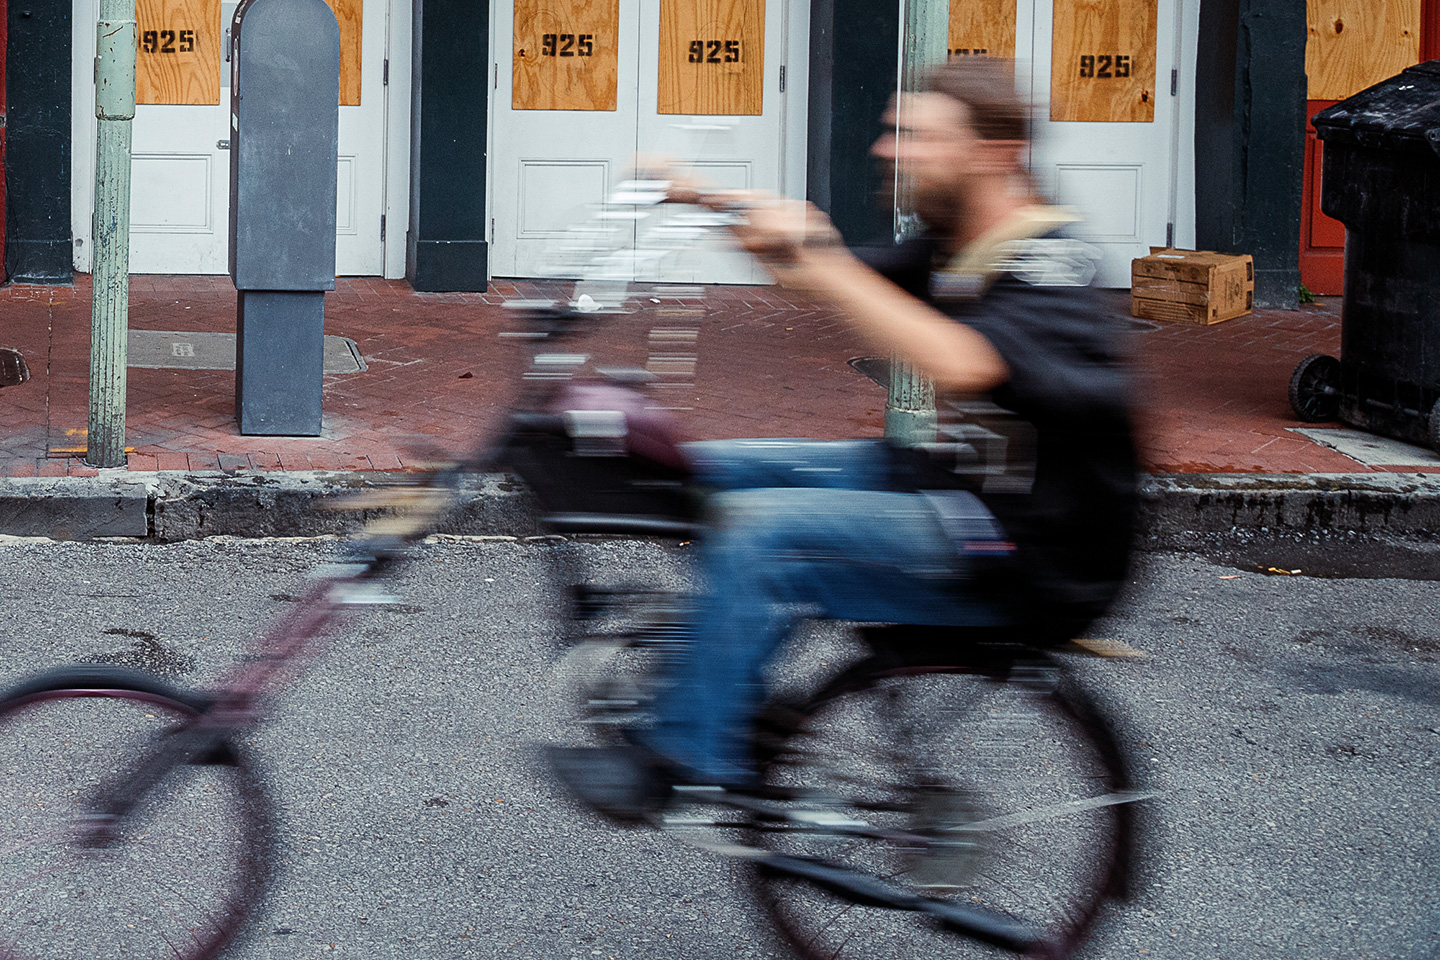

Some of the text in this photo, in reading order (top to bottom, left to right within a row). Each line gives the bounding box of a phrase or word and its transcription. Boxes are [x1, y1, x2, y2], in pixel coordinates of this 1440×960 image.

[142, 29, 194, 54] 925
[542, 34, 593, 57] 925
[688, 40, 740, 64] 925
[1079, 54, 1130, 79] 925
